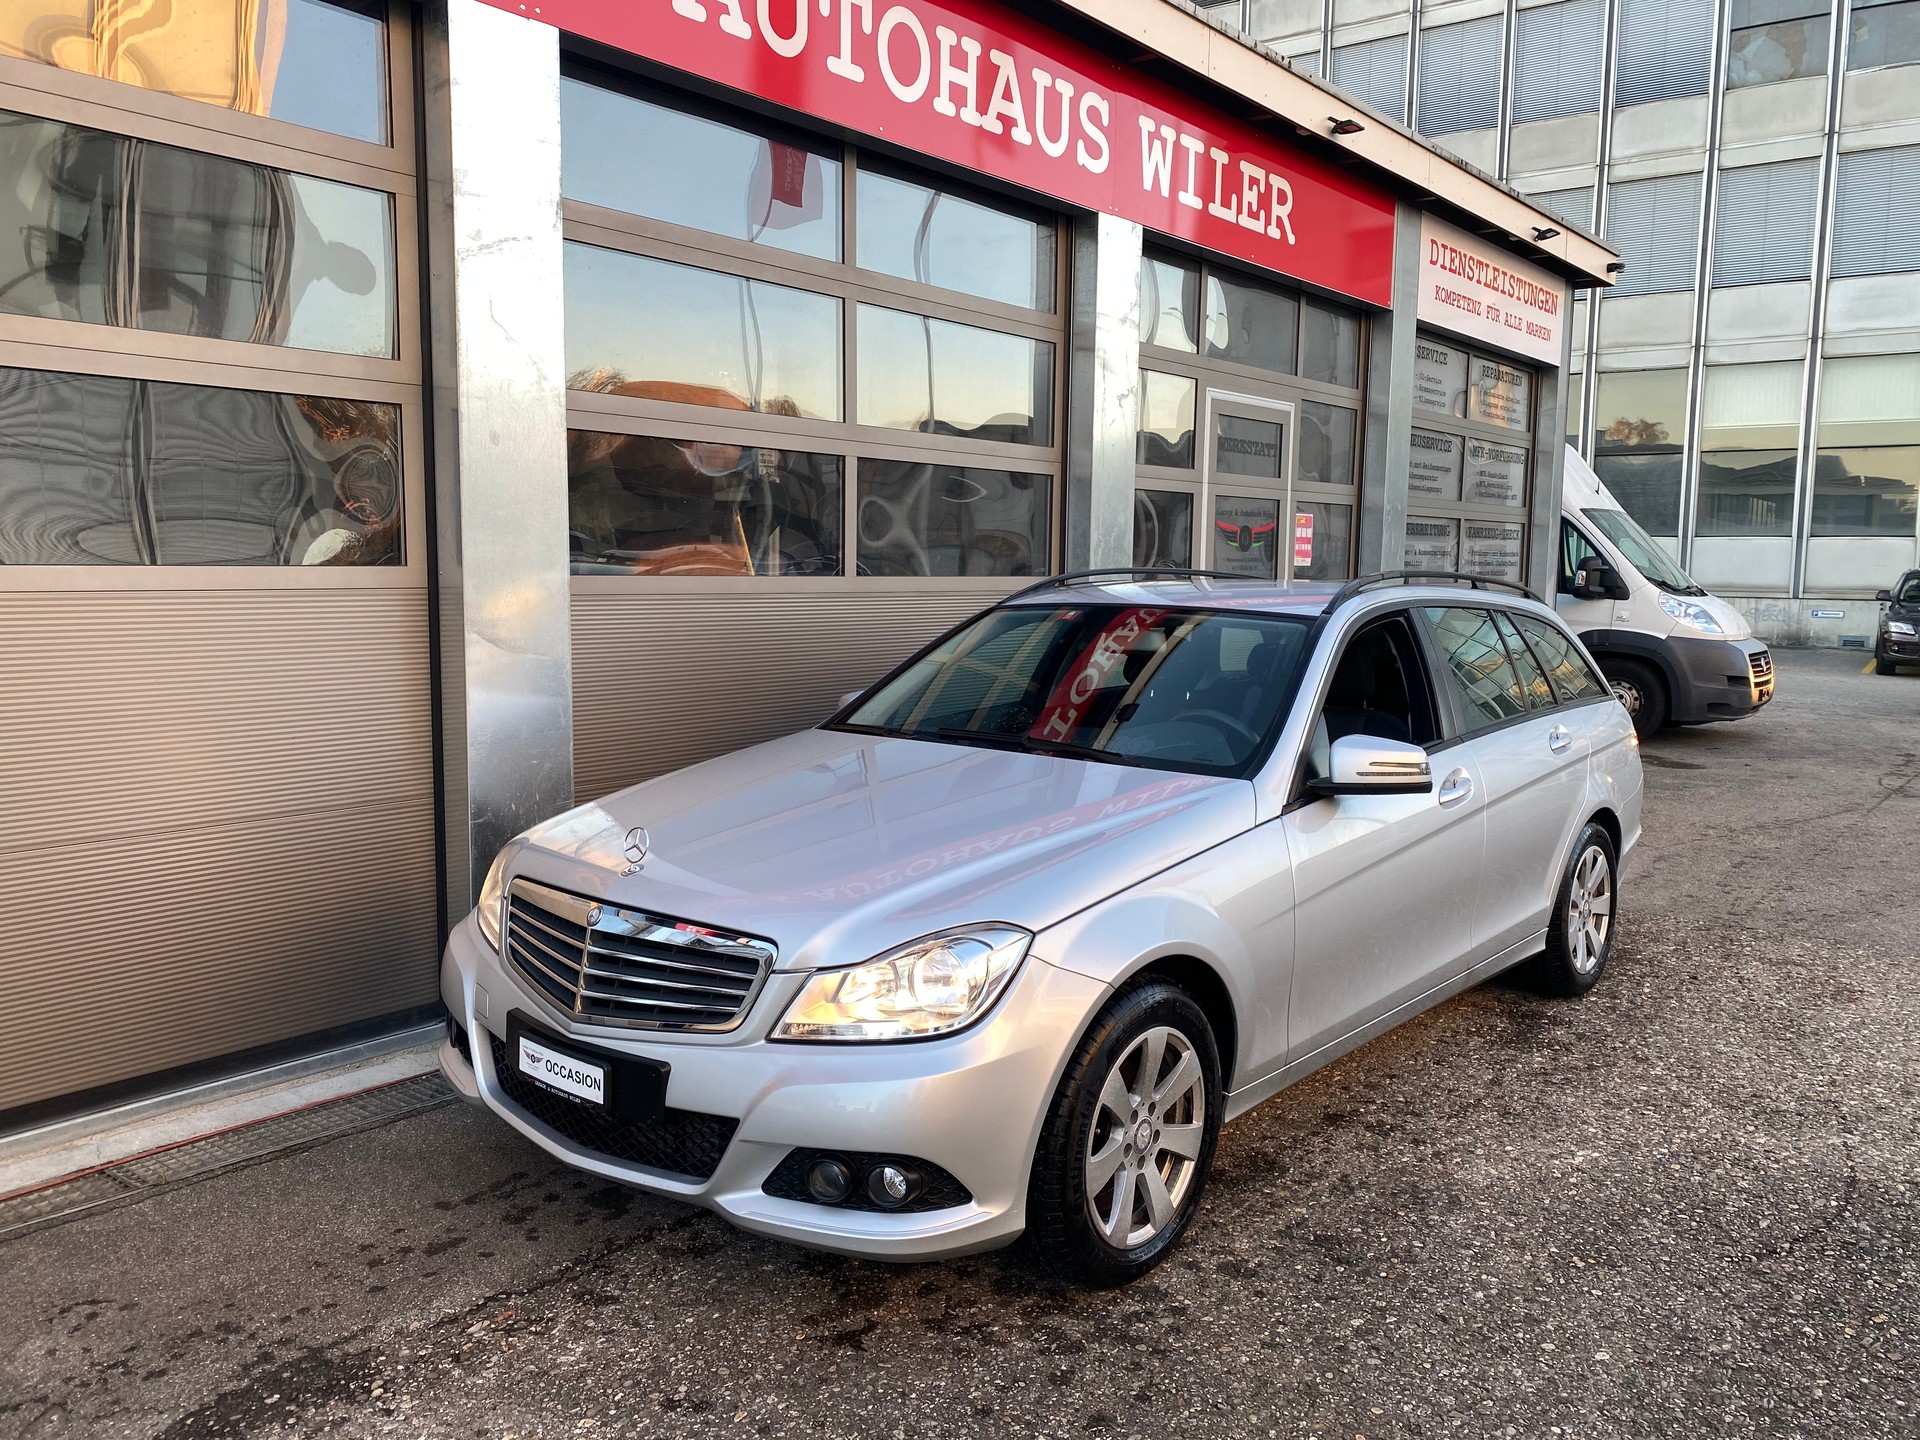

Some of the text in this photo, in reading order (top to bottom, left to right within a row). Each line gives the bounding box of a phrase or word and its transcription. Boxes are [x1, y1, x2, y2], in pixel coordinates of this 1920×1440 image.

[1138, 115, 1295, 245] WILER
[1429, 238, 1559, 317] DIENSTLEISTUNGEN
[1434, 284, 1552, 342] KOMPETENZ FÜR ALLE MARKEN
[1416, 345, 1448, 365] SERVICE
[1482, 365, 1523, 387] REPARATUREN
[1218, 436, 1278, 458] WERKSTATT
[545, 1059, 601, 1092] OCCASION
